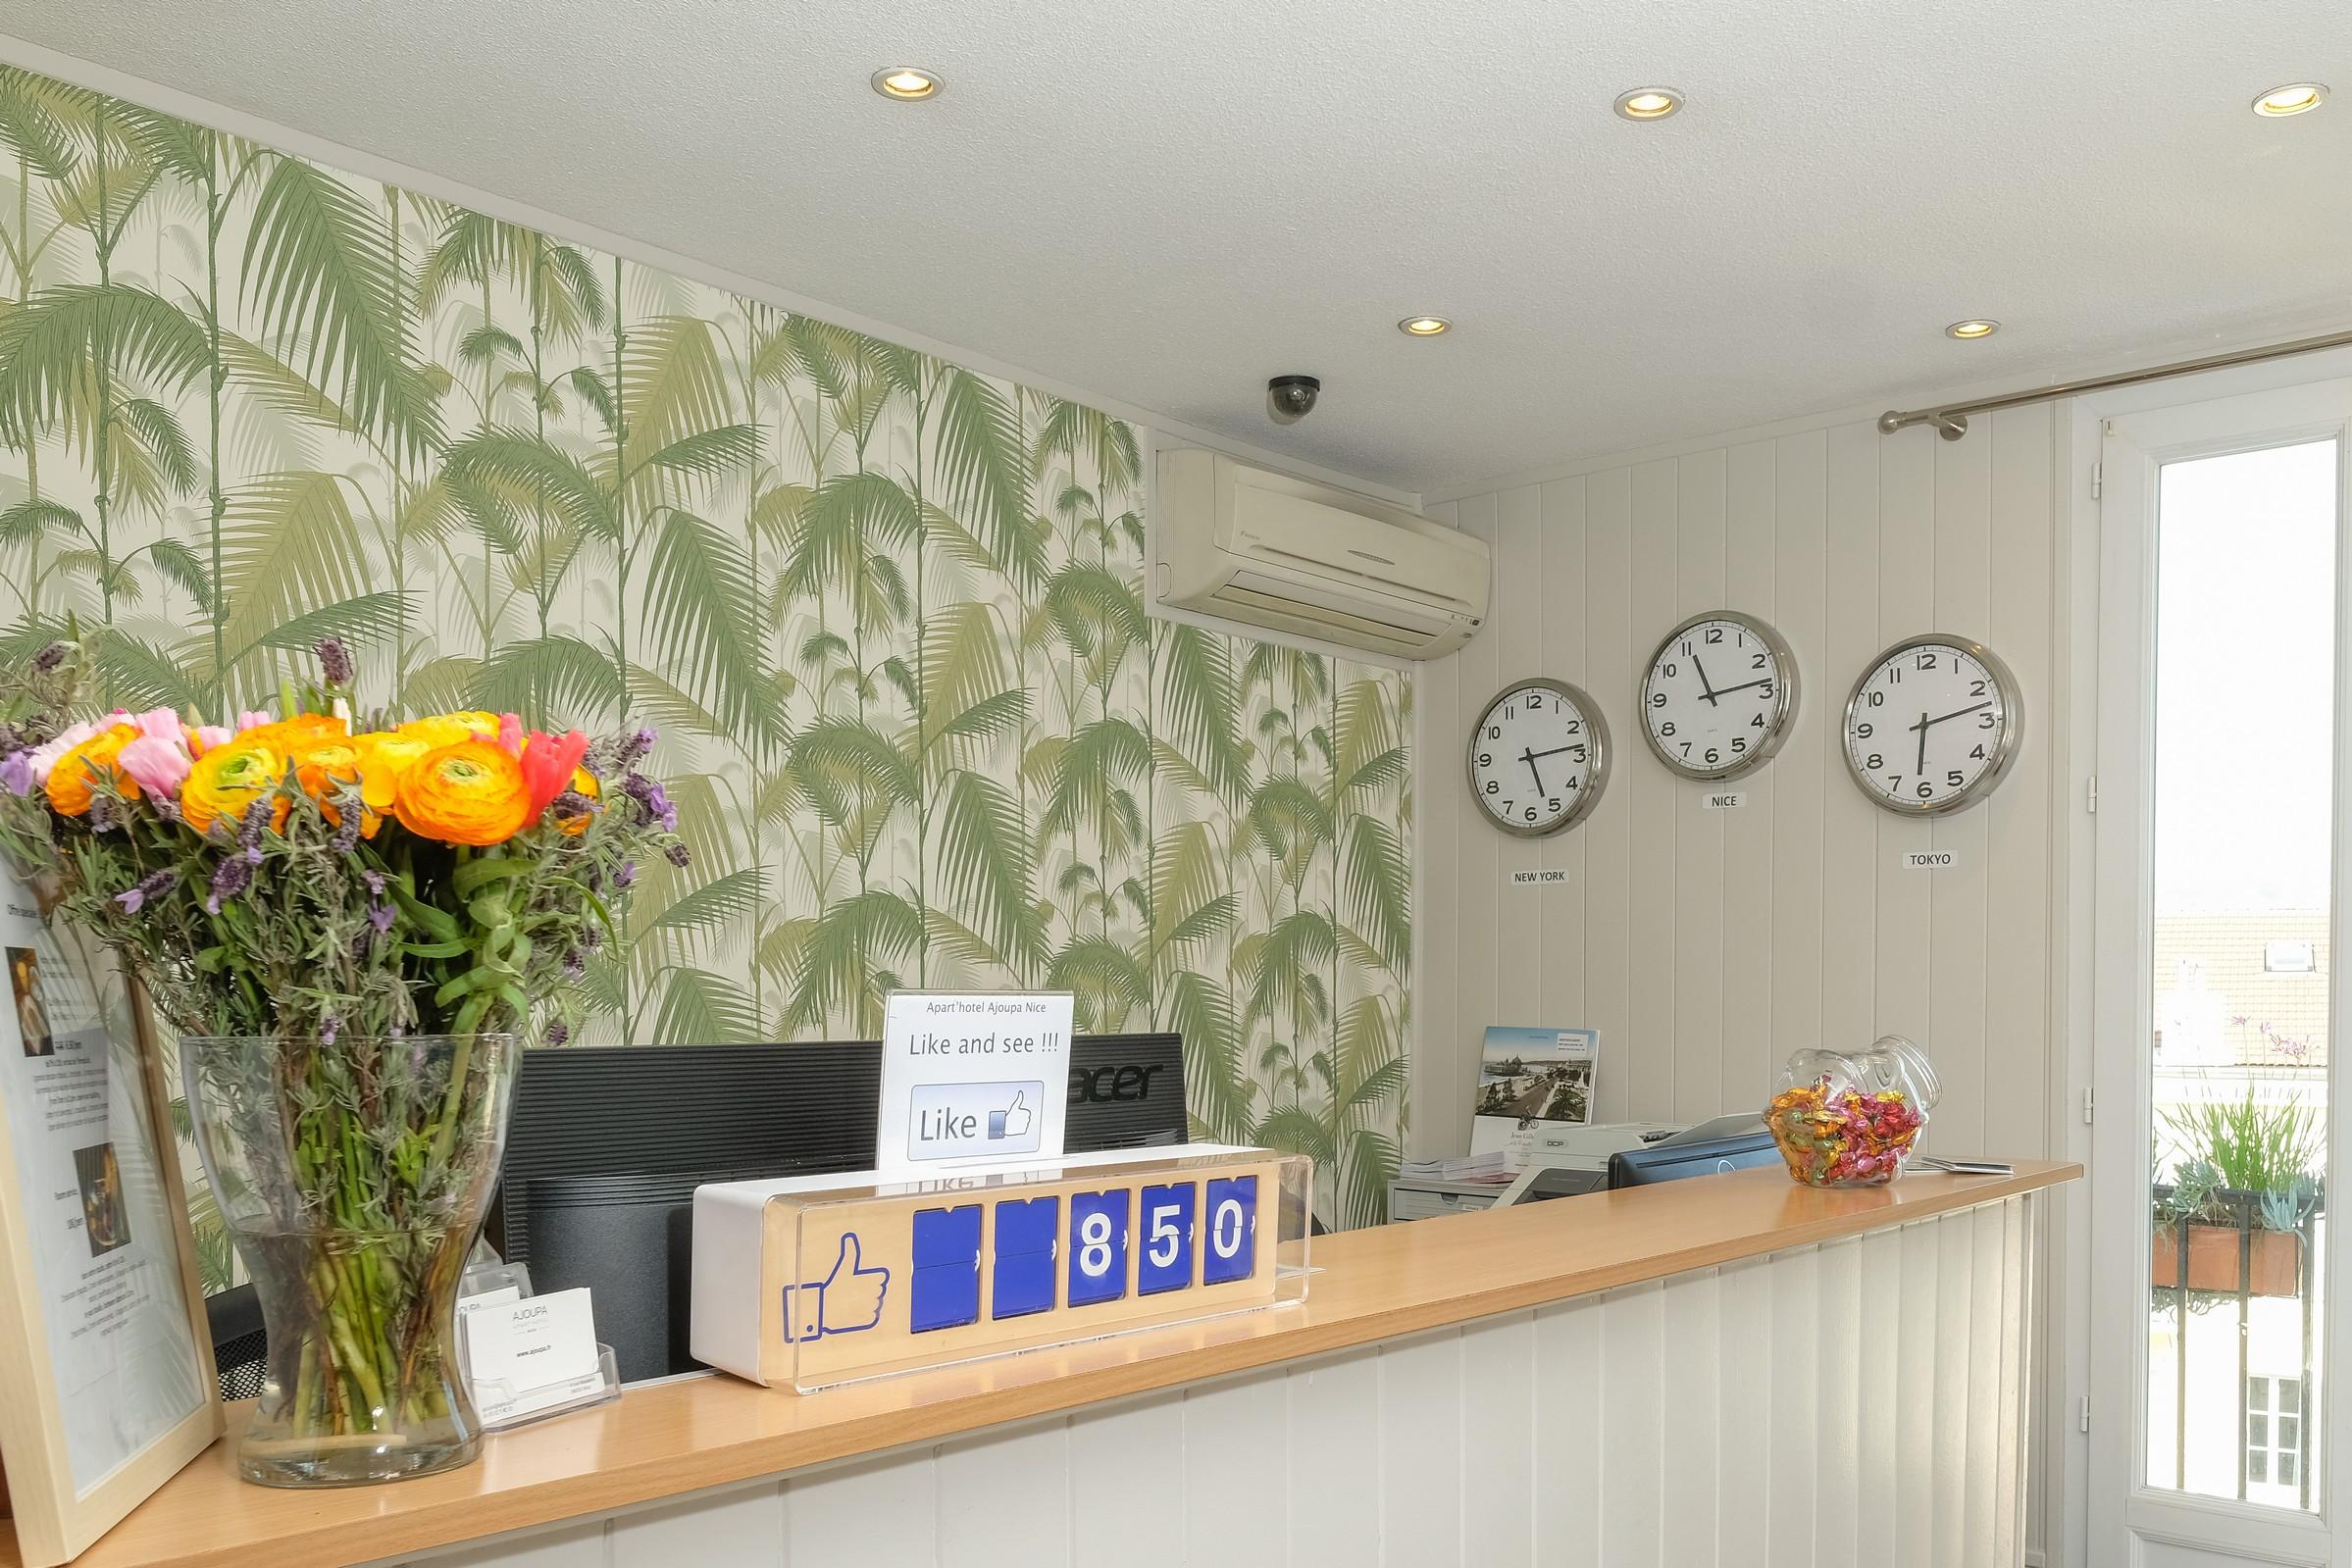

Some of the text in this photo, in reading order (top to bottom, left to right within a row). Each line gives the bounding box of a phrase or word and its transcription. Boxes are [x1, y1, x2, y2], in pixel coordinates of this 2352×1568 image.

[1706, 629, 1722, 644] 12
[1738, 633, 1742, 647] 1
[1682, 641, 1691, 656] 11
[1752, 653, 1765, 669] 2
[1917, 654, 1936, 671] 12
[1955, 658, 1959, 674] 1
[1663, 663, 1676, 679] 10
[1890, 668, 1901, 683] 11
[1759, 683, 1773, 699] 3
[1969, 681, 1986, 696] 2
[1526, 695, 1542, 709] 12
[1653, 693, 1666, 708] 9
[1868, 691, 1883, 707] 10
[1506, 706, 1513, 720] 11
[1556, 700, 1559, 714] 1
[1567, 720, 1579, 734] 2
[1751, 713, 1764, 728] 4
[1978, 713, 1995, 729] 3
[1488, 726, 1501, 739] 10
[1662, 722, 1675, 736] 8
[1858, 724, 1872, 738] 9
[1679, 742, 1692, 757] 7
[1731, 737, 1746, 752] 5
[1969, 744, 1985, 760] 4
[1479, 754, 1491, 767] 9
[1573, 748, 1586, 763] 3
[1705, 748, 1718, 763] 6
[1866, 753, 1883, 769] 8
[1565, 776, 1578, 789] 4
[1888, 776, 1902, 791] 7
[1947, 770, 1964, 786] 5
[1486, 781, 1499, 794] 8
[1917, 782, 1933, 797] 6
[1503, 801, 1513, 814] 7
[1549, 798, 1561, 812] 5
[1712, 796, 1737, 807] NICE
[1524, 807, 1537, 821] 6
[1911, 854, 1951, 865] TOKYO
[1514, 871, 1565, 883] NEW YORK
[927, 1001, 1047, 1015] Apart'hotel Ajoupa Nice
[910, 1033, 1059, 1055] Like and see !!!
[920, 1106, 977, 1141] Like
[512, 1305, 548, 1321] AJOUPA
